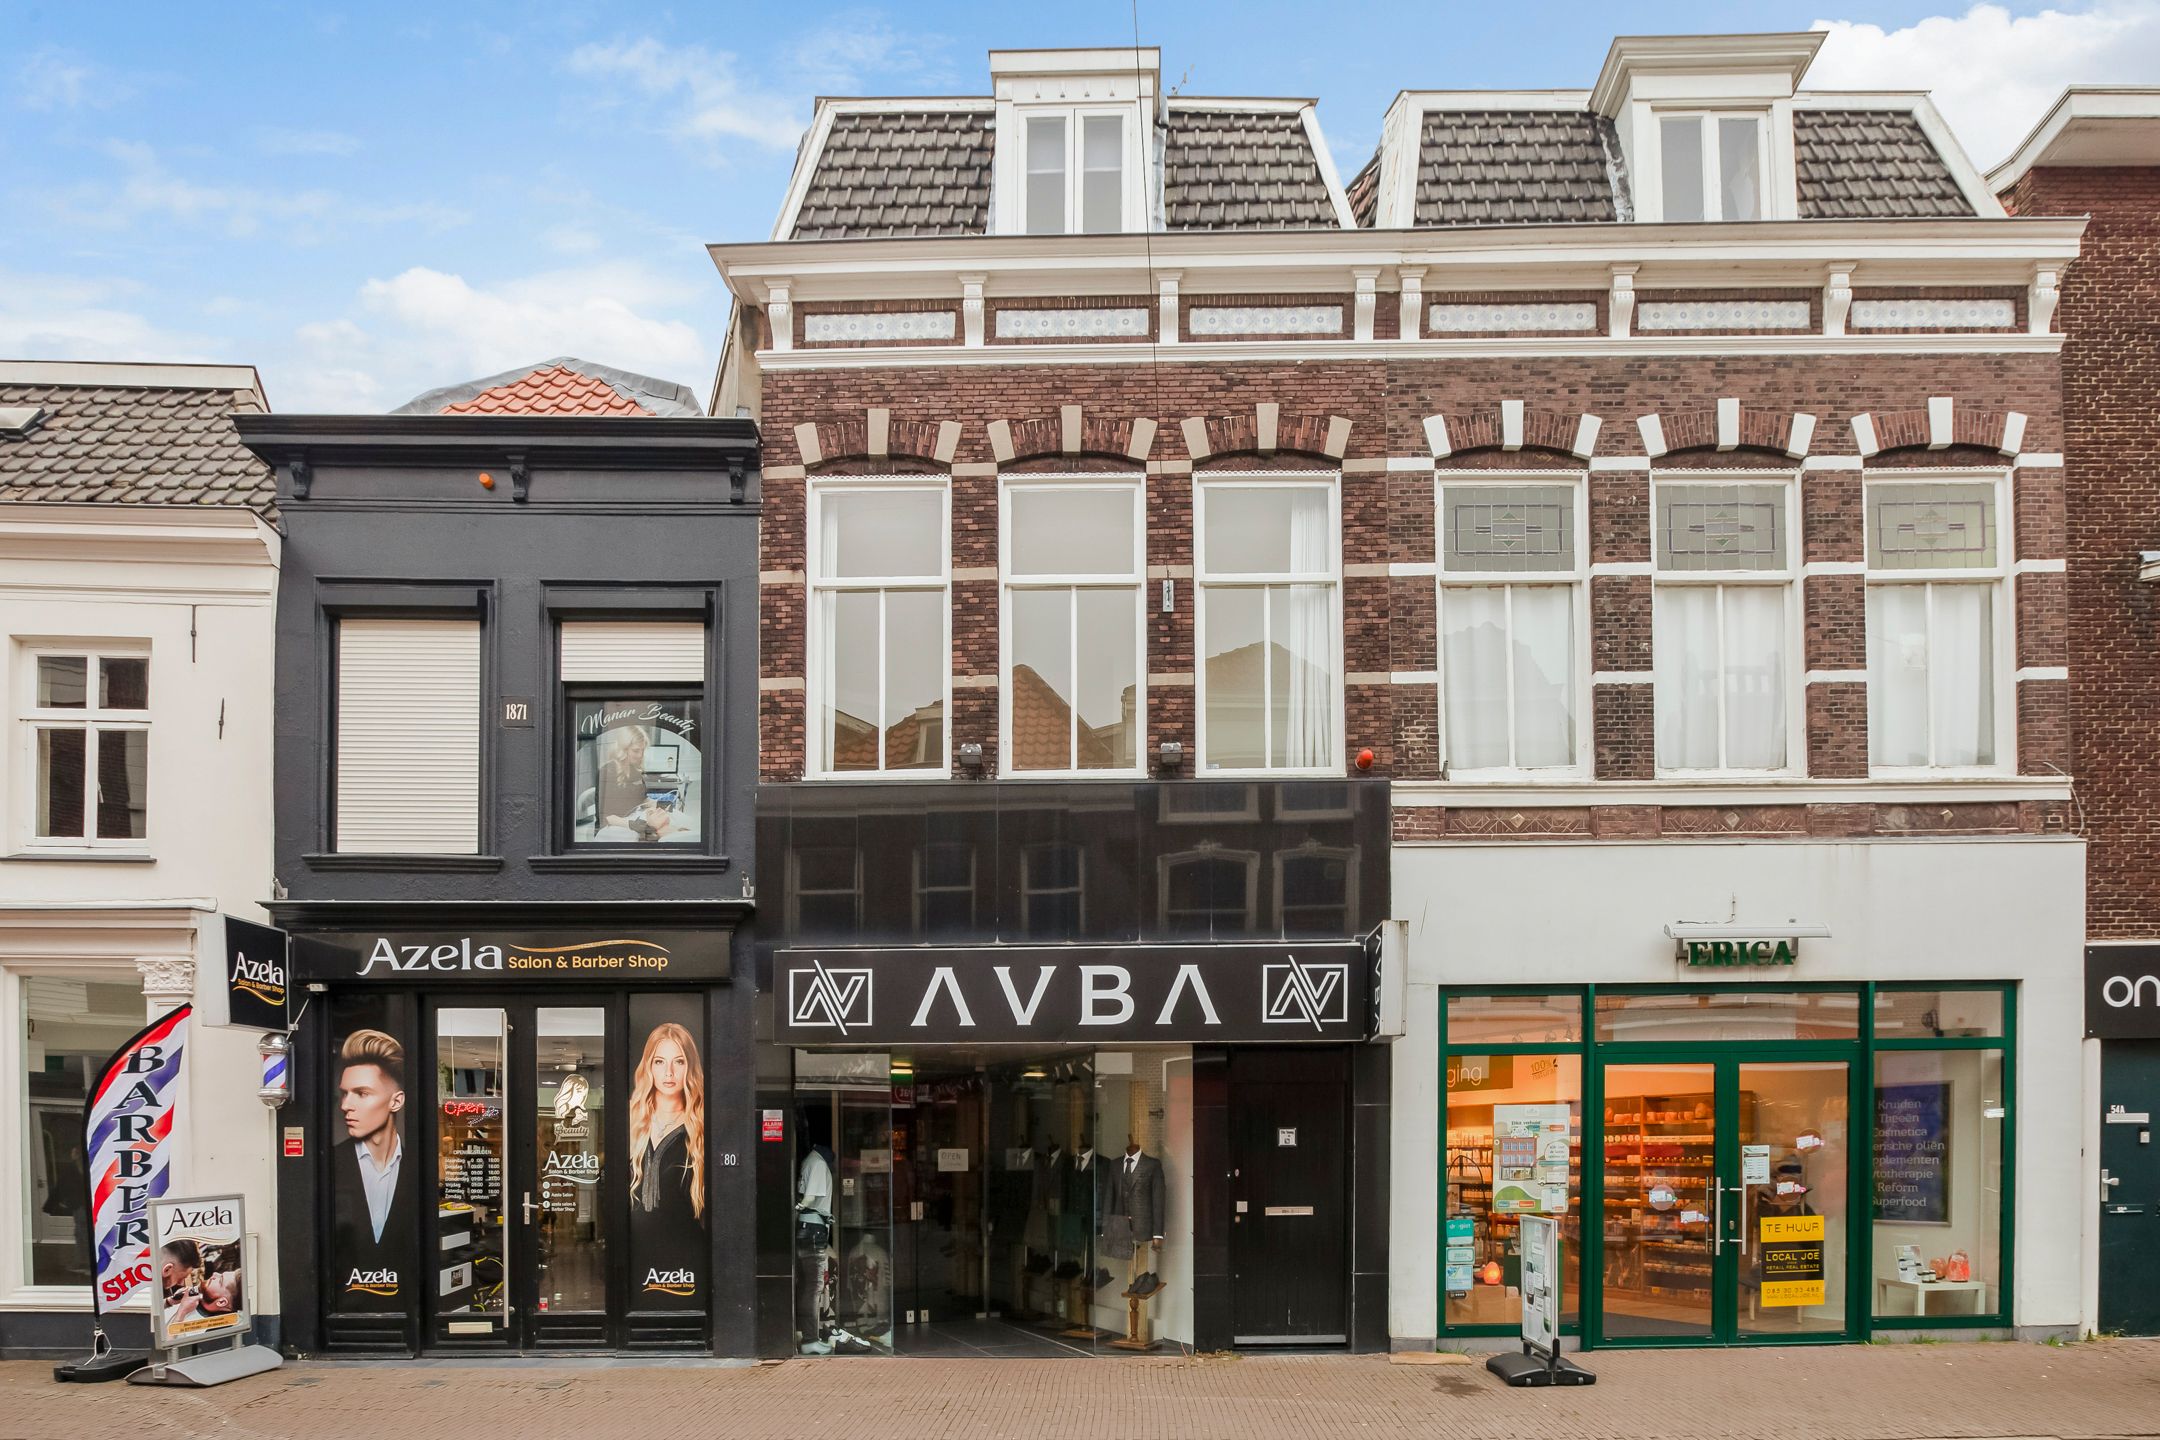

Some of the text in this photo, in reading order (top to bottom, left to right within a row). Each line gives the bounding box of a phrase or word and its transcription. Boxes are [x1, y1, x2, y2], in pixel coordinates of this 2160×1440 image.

[505, 703, 528, 721] 1871
[580, 703, 697, 735] Manar Beauty
[356, 937, 669, 976] Azela Salon & Barber Shop
[1687, 940, 1794, 967] ERICA
[230, 951, 285, 986] Azela
[444, 1100, 486, 1117] Open
[1878, 1100, 1921, 1110] Kruiden
[2110, 1105, 2125, 1114] 54A
[112, 1045, 165, 1250] BARBER
[541, 1150, 600, 1171] Azela
[724, 1153, 737, 1166] 80
[1877, 1182, 1919, 1193] Reform
[163, 1205, 233, 1236] Azela
[1766, 1222, 1820, 1233] TE HUUR
[1766, 1252, 1820, 1262] LOCAL JOE
[102, 1263, 153, 1303] SHO
[345, 1268, 398, 1286] Azela
[642, 1268, 695, 1286] Azela
